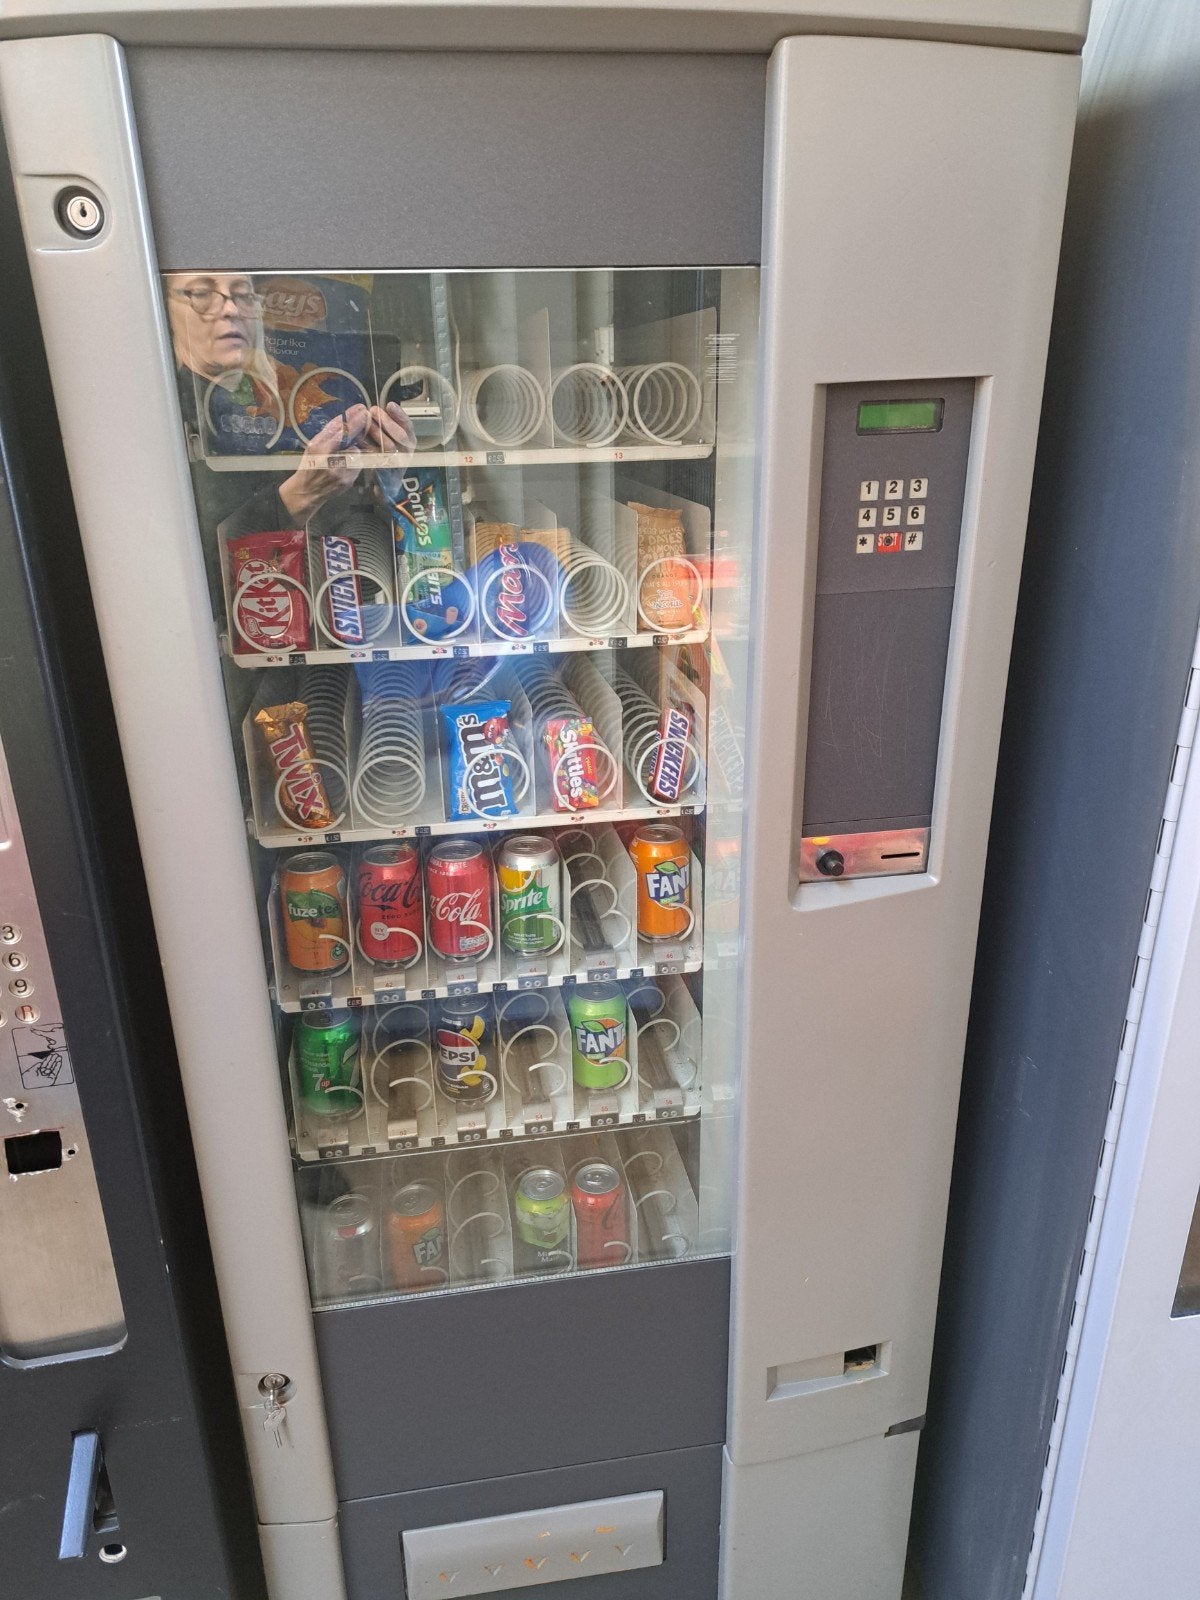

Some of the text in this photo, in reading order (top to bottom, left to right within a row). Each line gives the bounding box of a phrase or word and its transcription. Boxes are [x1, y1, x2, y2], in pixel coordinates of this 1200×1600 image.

[865, 480, 922, 495] 1 2 3
[401, 477, 432, 546] Doritos
[862, 507, 919, 522] 4 5 6
[325, 535, 360, 635] SNICKERS
[497, 543, 528, 636] Mars
[560, 724, 583, 798] Skittles
[659, 711, 688, 798] SNICKERS
[501, 887, 543, 914] Sprite
[288, 903, 318, 917] fuze
[2, 925, 15, 941] 3
[9, 953, 21, 968] 6
[15, 979, 28, 993] 9
[21, 1005, 34, 1020] R
